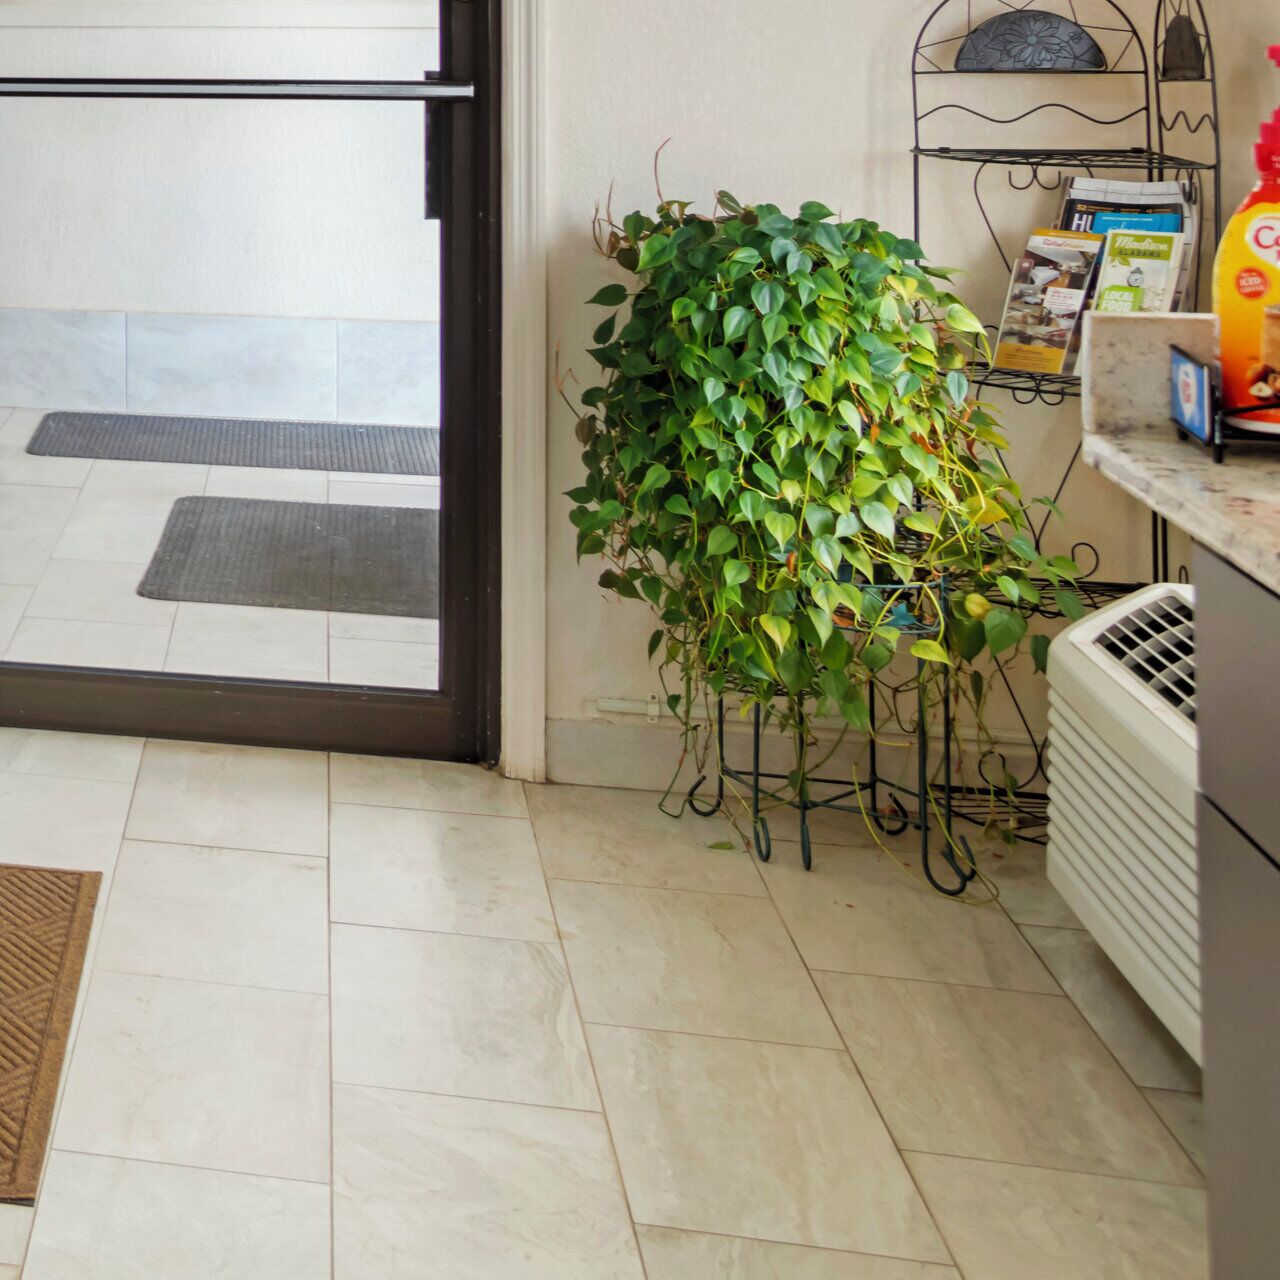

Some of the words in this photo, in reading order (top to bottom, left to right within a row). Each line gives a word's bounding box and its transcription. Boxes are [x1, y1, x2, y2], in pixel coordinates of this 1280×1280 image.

[1114, 235, 1169, 253] Madison
[1118, 248, 1161, 258] ALABAMA
[1239, 277, 1261, 286] ICED
[1104, 290, 1135, 301] LOCAL
[1100, 300, 1133, 312] FOOD
